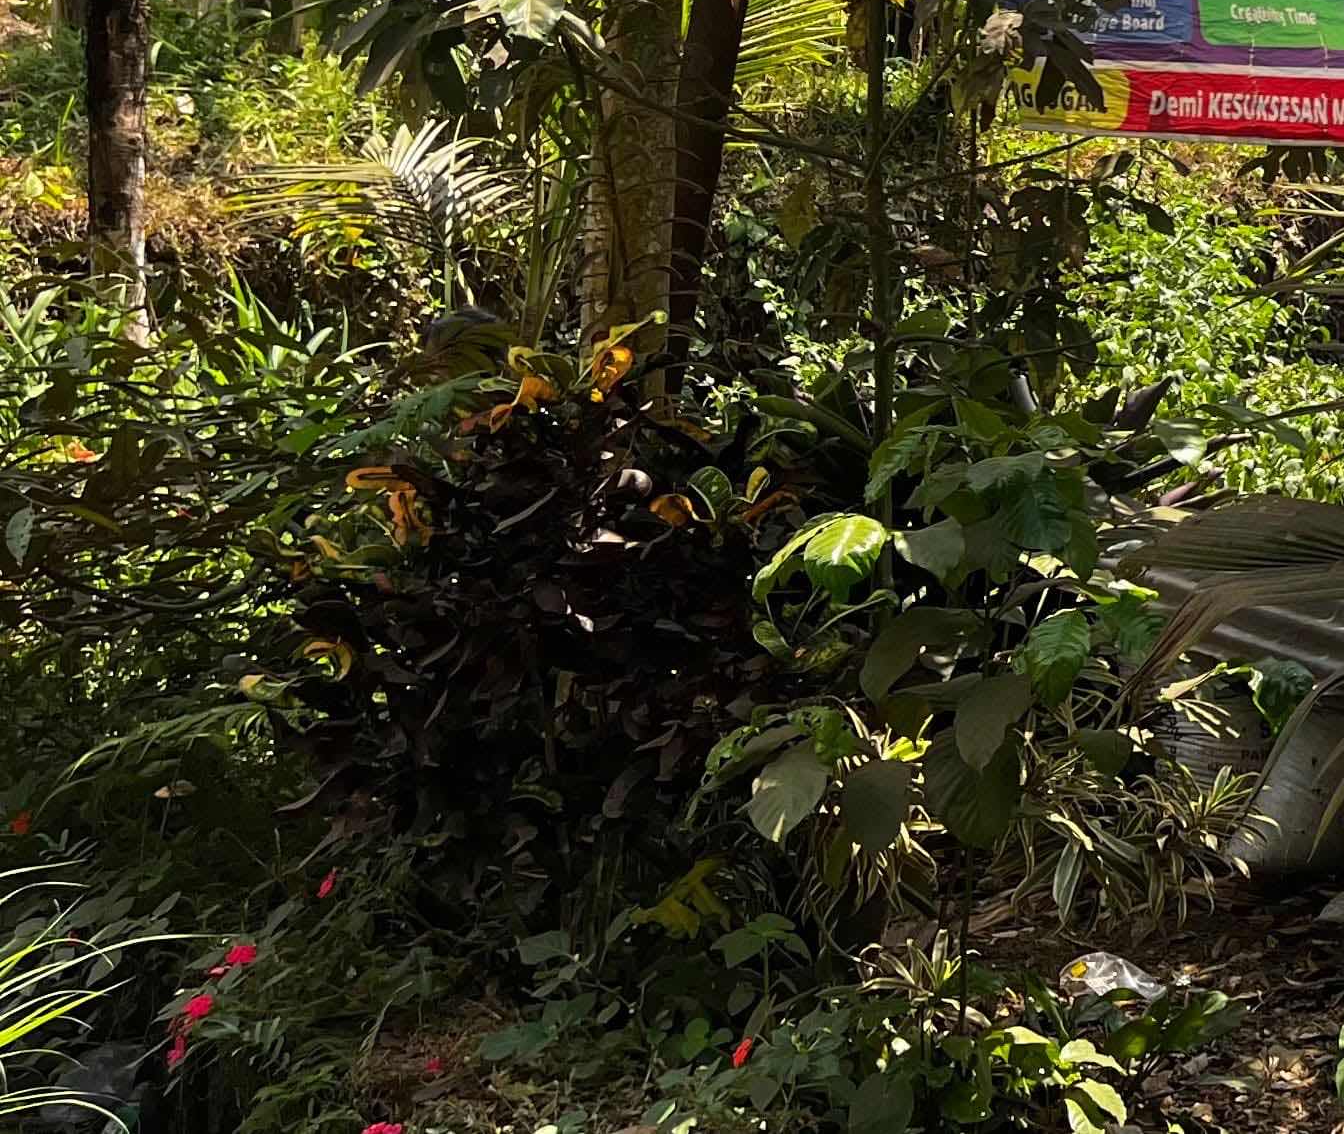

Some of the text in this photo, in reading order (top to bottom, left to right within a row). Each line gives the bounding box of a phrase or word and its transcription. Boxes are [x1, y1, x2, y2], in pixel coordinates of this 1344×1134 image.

[1122, 13, 1166, 31] Board
[1149, 89, 1203, 118] Demi
[1207, 90, 1329, 126] KESUKSESAN
